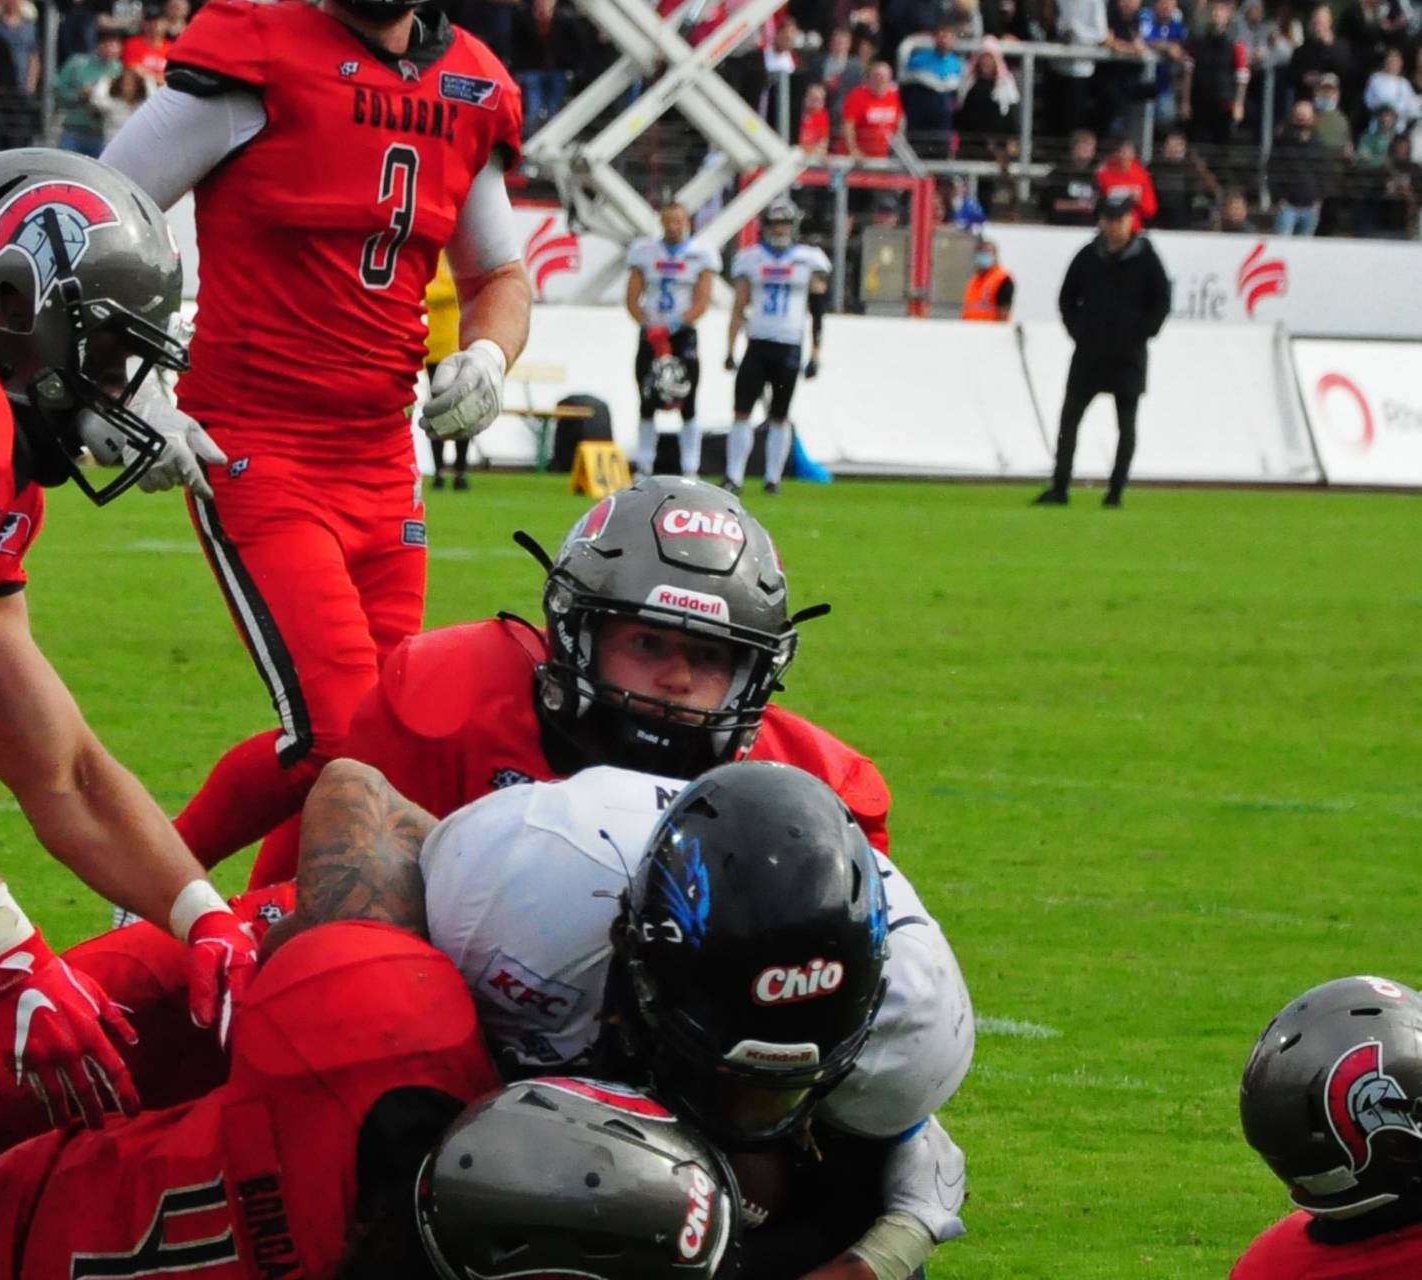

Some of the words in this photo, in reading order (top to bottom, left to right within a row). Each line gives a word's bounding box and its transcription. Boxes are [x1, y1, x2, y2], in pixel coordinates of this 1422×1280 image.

[354, 88, 458, 144] COLOGNE
[359, 142, 421, 289] 3
[659, 278, 675, 312] 5
[662, 509, 744, 540] Chio
[659, 591, 722, 615] Riddell
[488, 969, 568, 1018] KFC
[756, 959, 844, 1002] Chio
[680, 1168, 710, 1259] Chio
